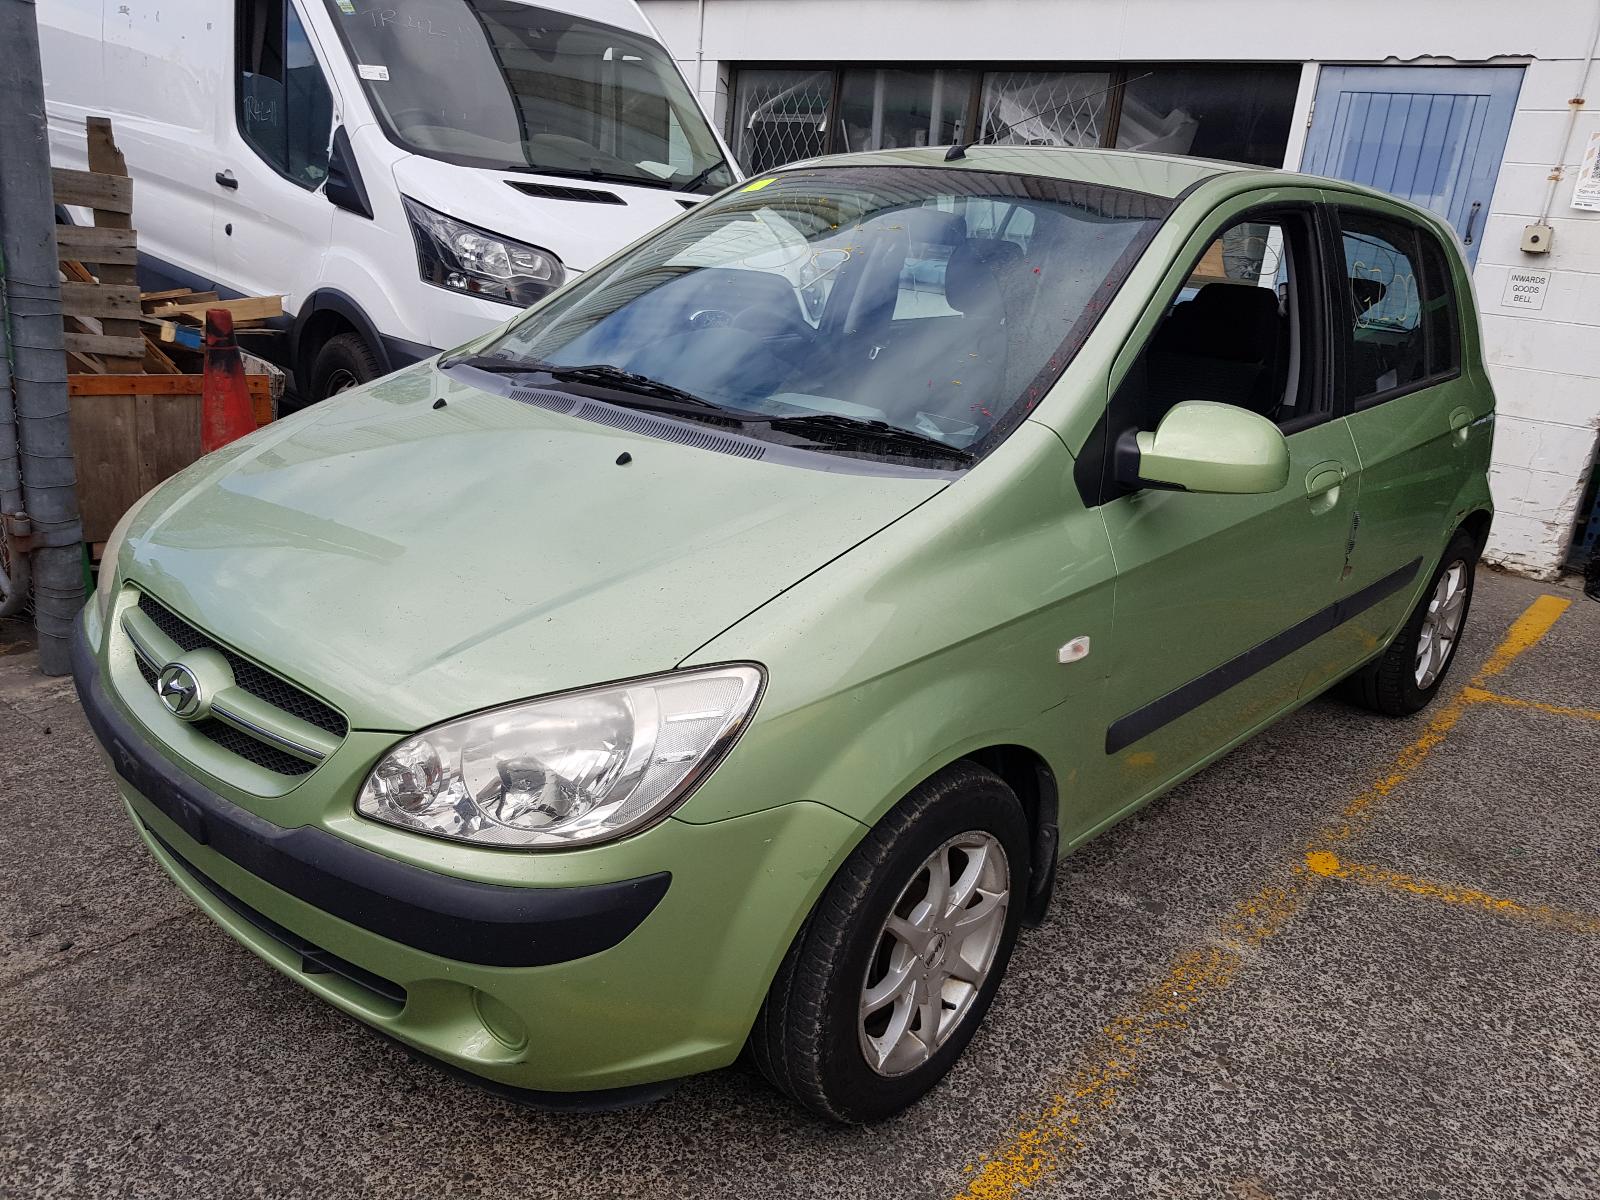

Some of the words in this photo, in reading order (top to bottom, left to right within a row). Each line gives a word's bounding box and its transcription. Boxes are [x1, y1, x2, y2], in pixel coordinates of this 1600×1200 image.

[1511, 274, 1546, 285] INWARDS
[1512, 284, 1540, 294] GOODS
[1513, 294, 1532, 303] BELL
